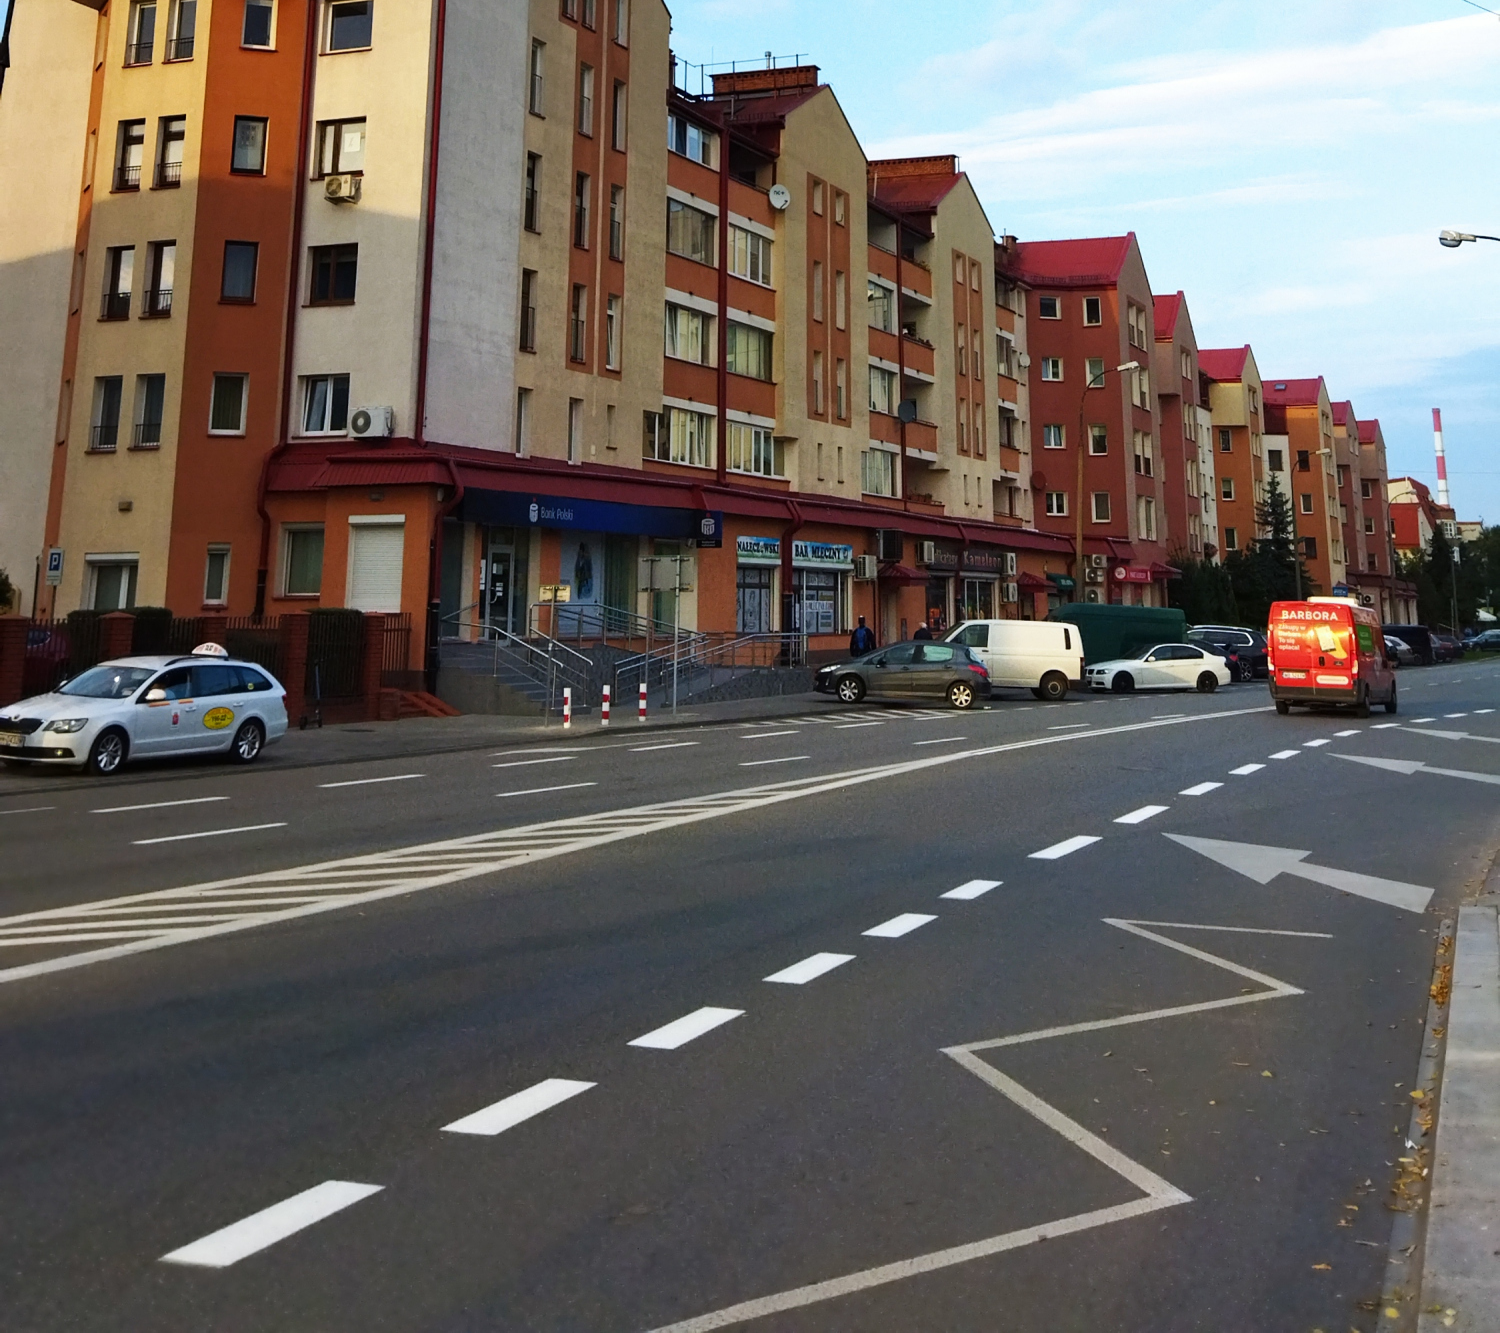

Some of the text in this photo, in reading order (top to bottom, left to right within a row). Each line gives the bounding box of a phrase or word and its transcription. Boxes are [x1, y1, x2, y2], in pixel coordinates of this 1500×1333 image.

[541, 506, 556, 520] Bank
[556, 508, 574, 521] Polski
[737, 541, 780, 555] NAŁĘCZWSKI
[795, 544, 842, 560] BAR MLECZNY
[52, 554, 60, 569] P
[963, 550, 1002, 568] Kameleon
[1282, 610, 1338, 621] BARBORA
